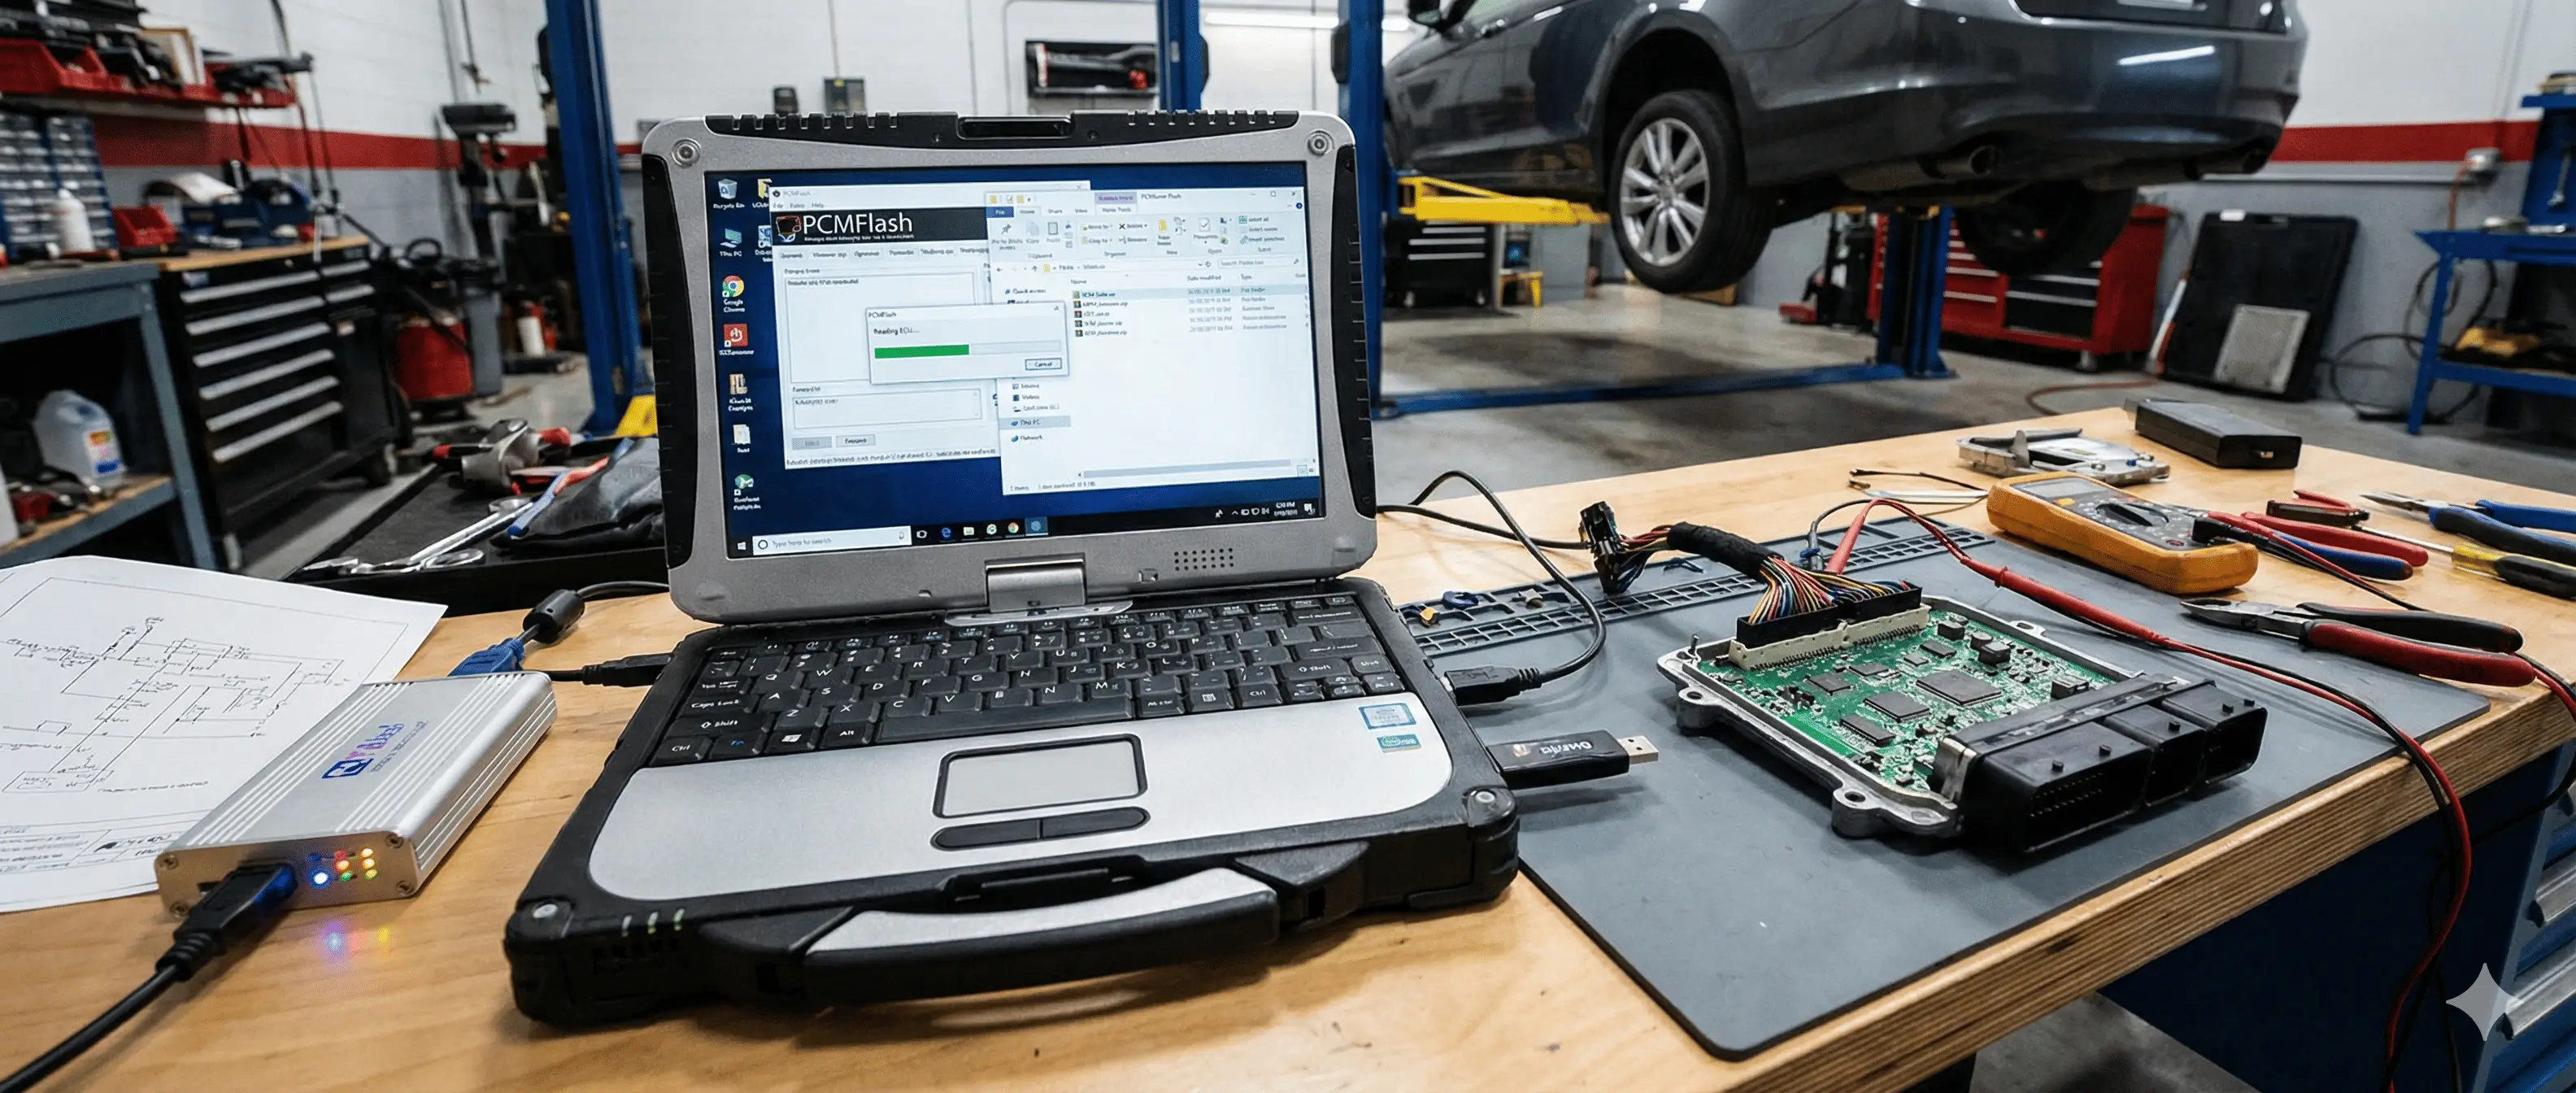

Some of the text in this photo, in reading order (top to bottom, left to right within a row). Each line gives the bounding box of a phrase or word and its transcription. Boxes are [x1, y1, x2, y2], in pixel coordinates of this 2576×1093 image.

[803, 212, 912, 235] PCMFlash
[816, 668, 833, 677] W
[872, 682, 884, 690] D
[1095, 681, 1108, 690] M
[821, 687, 831, 695] S
[1045, 686, 1055, 694] N
[945, 695, 955, 703] V
[840, 704, 852, 712] X
[787, 709, 799, 717] Z
